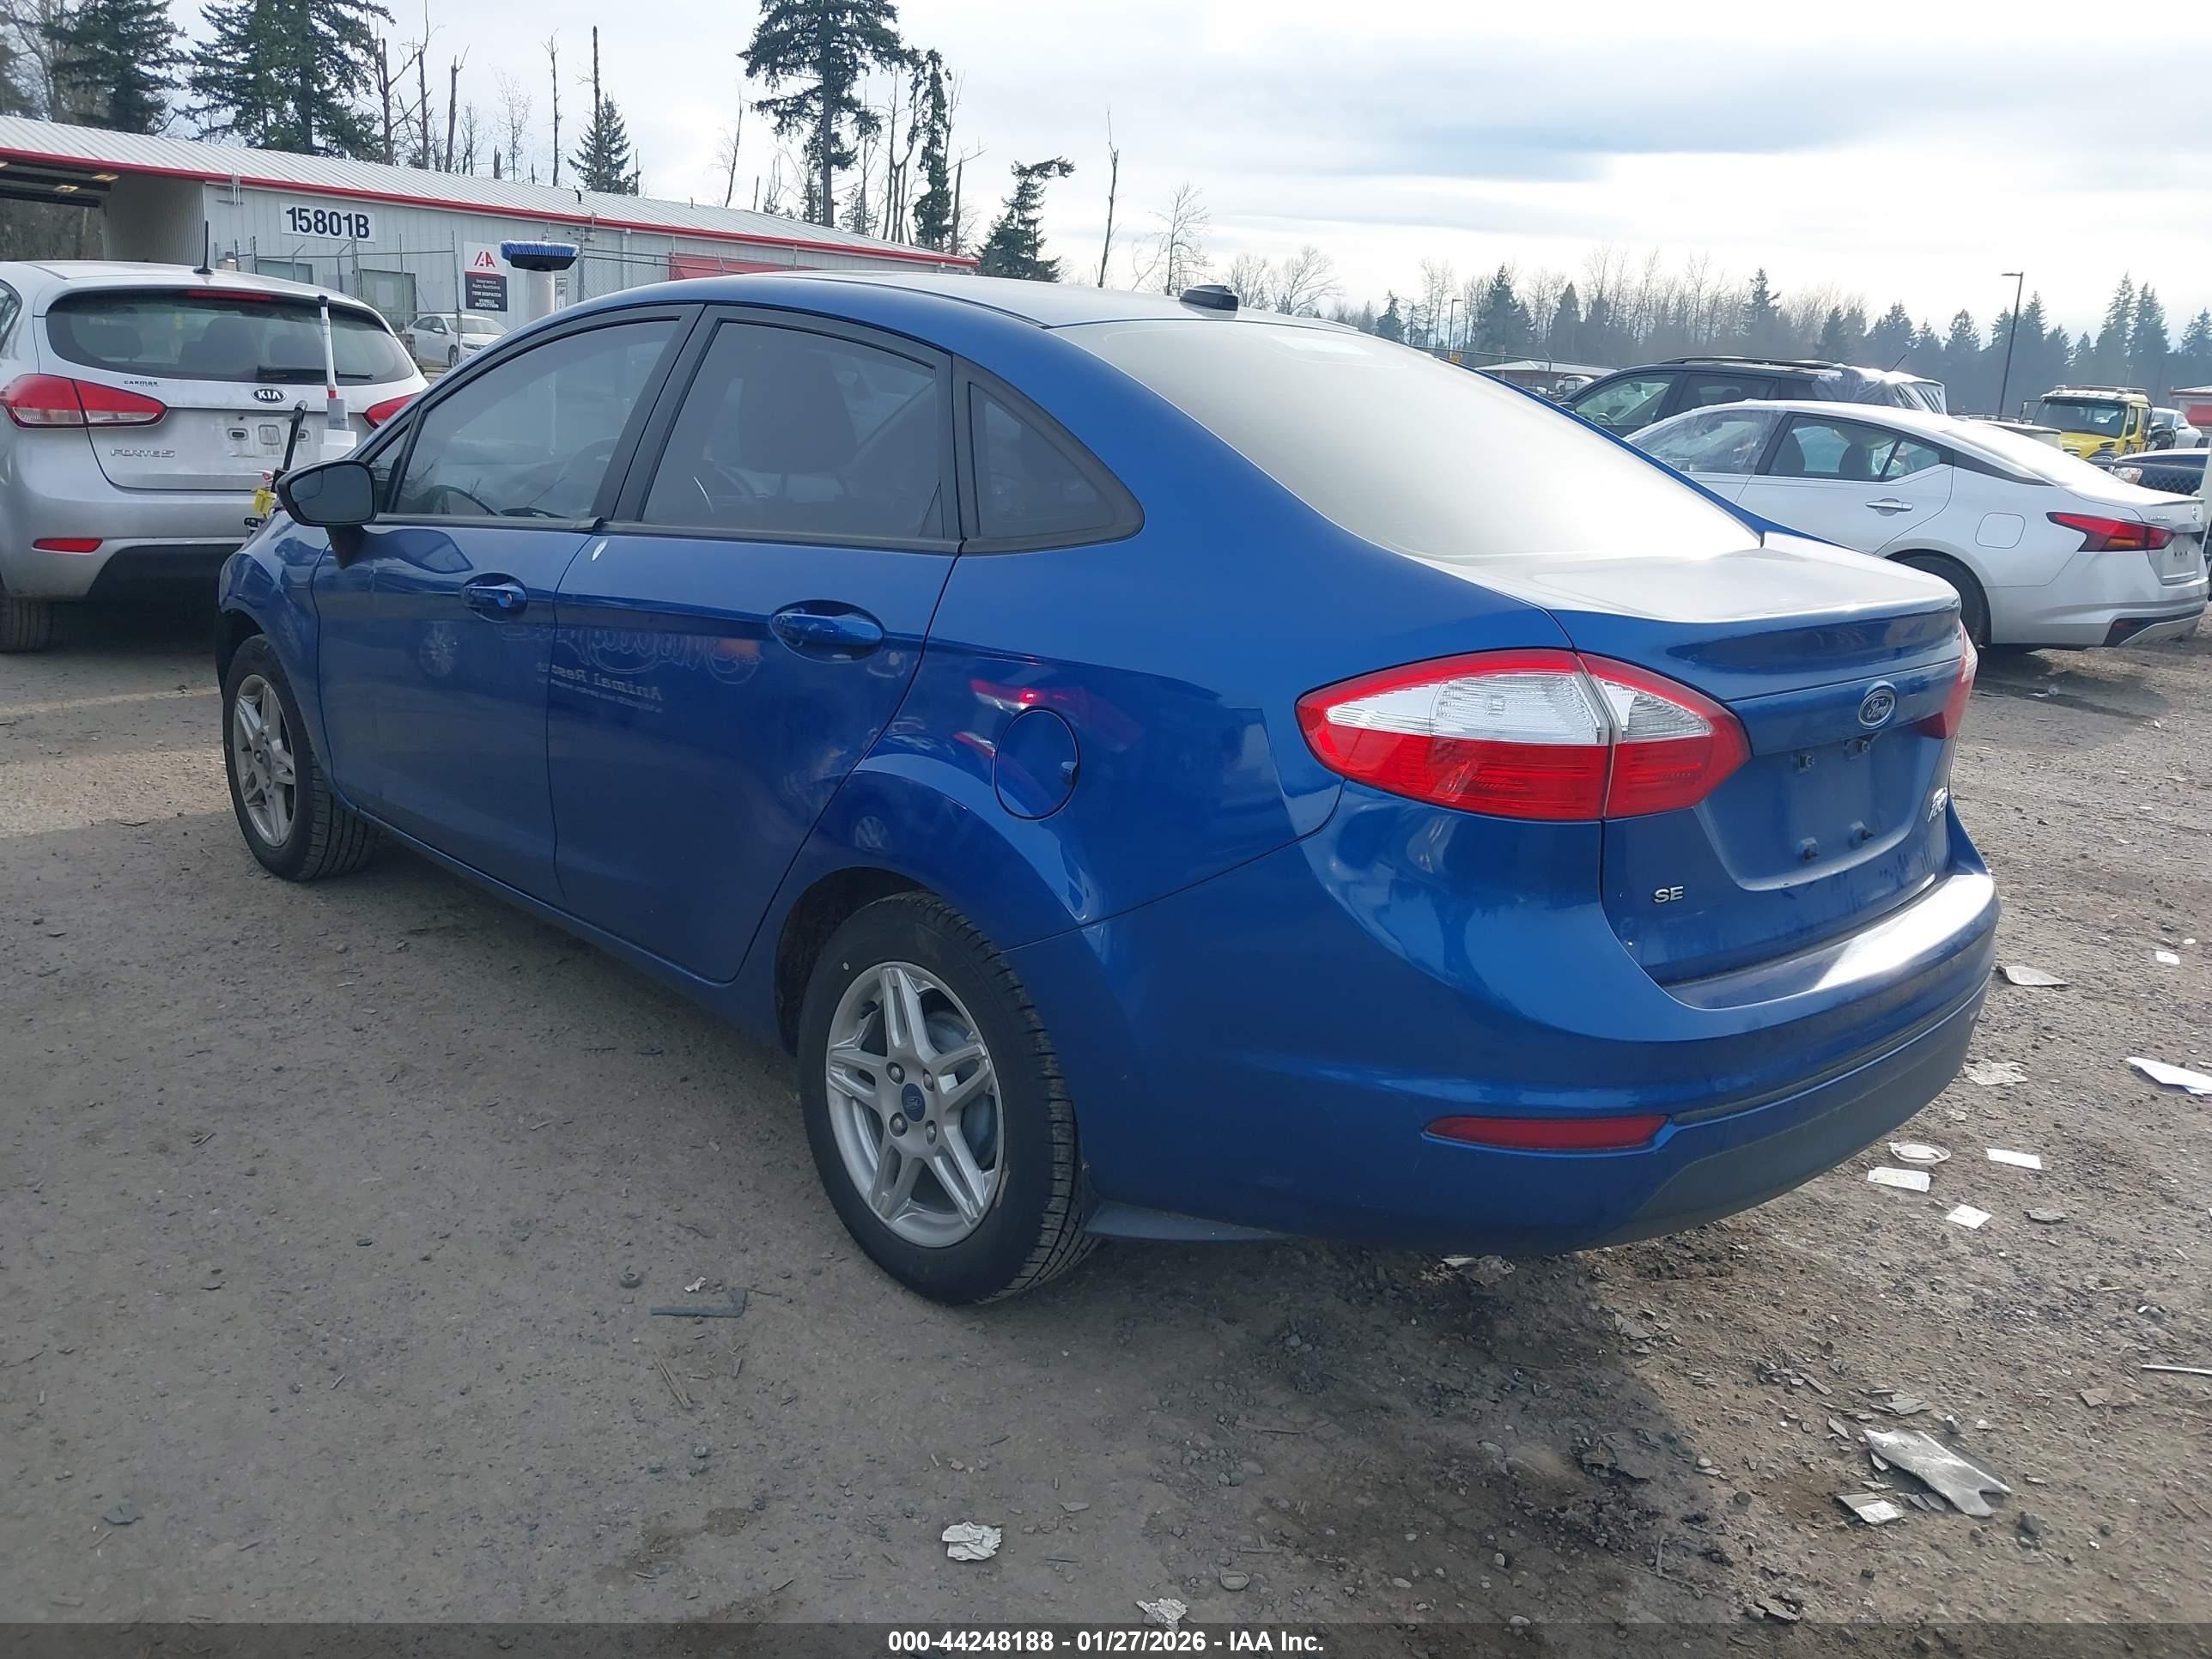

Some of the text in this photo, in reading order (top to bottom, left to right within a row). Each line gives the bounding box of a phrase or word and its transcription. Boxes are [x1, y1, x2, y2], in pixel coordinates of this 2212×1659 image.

[285, 206, 370, 239] 15801B
[258, 390, 282, 400] KIA
[1866, 696, 1890, 720] Ford
[1653, 885, 1684, 903] SE
